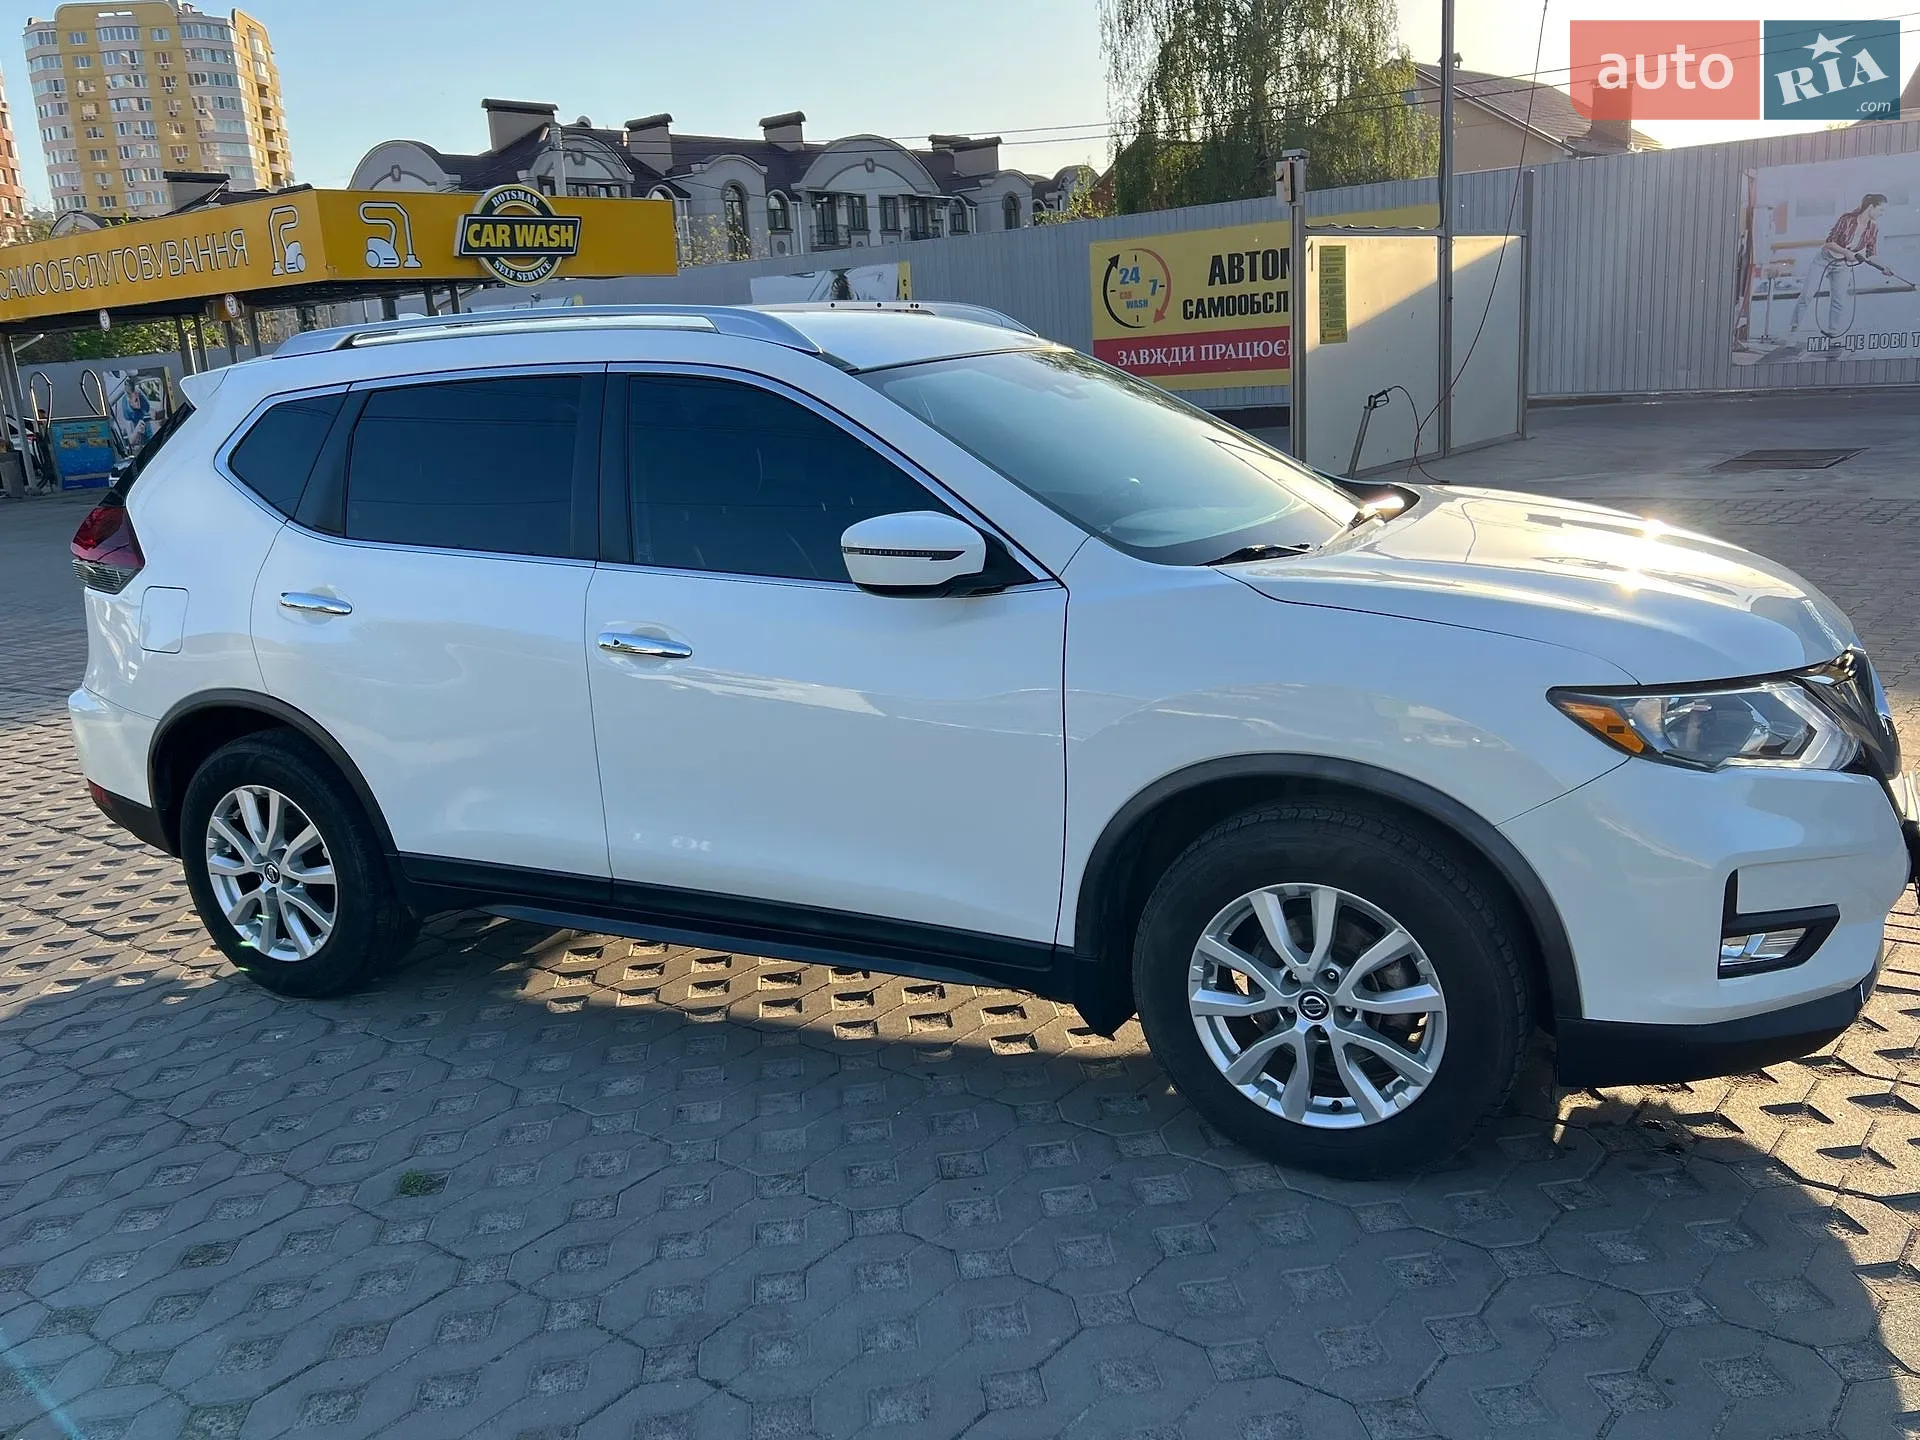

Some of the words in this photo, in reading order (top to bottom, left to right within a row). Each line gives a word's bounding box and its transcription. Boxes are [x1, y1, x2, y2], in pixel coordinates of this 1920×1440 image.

[491, 190, 540, 207] BOTSMAN
[467, 223, 511, 248] CAR
[514, 224, 574, 248] WASH
[494, 260, 516, 280] SELF
[516, 260, 552, 281] SERVICE
[1119, 265, 1141, 285] 24
[1126, 299, 1149, 309] WASH
[1807, 337, 1830, 352] МИ
[1845, 334, 1865, 352] ЦЕ
[1868, 332, 1908, 350] НОВІ
[1117, 346, 1195, 367] ЗАВЖДИ
[1200, 339, 1291, 363] ПРАЦЮЄ
